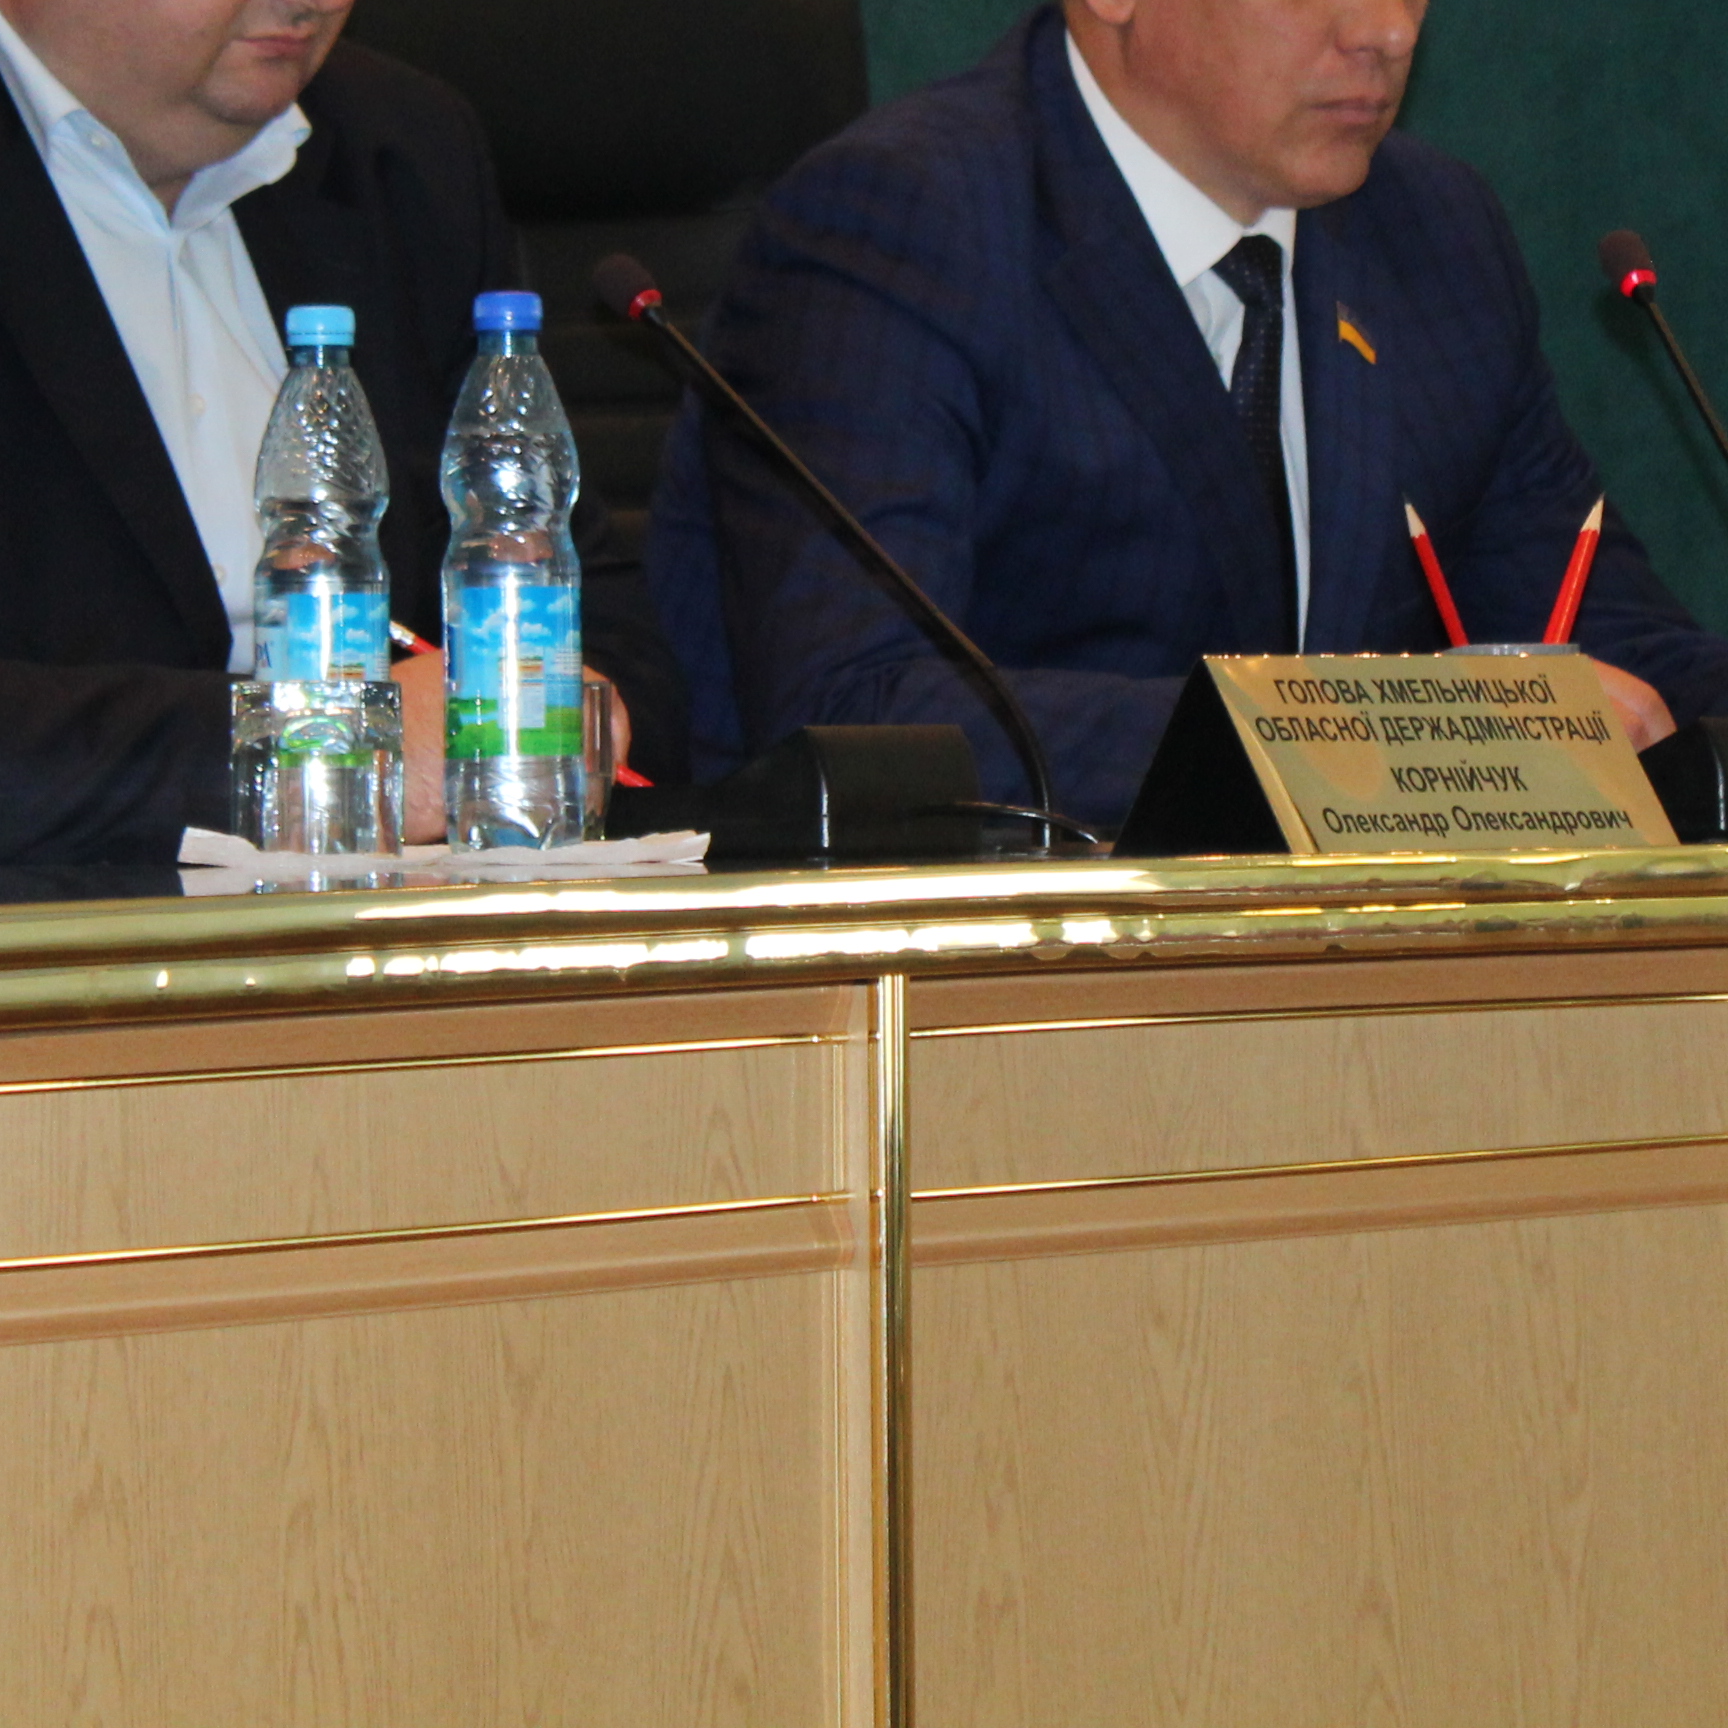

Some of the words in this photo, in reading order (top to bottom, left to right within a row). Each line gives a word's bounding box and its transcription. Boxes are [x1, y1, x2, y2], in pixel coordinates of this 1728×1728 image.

[1273, 678, 1374, 704] ГОЛОВА
[1372, 674, 1557, 708] ХМЕЛЬНИЦЬКОЇ
[1255, 710, 1379, 742] ОБЛАСНОЇ
[1379, 710, 1612, 746] ДЕРЖАДМІНІСТРАЦІЇ
[1389, 758, 1529, 793] КОРНІЙЧУК
[1322, 807, 1451, 838] Олександр
[1451, 805, 1635, 836] Олександрович
